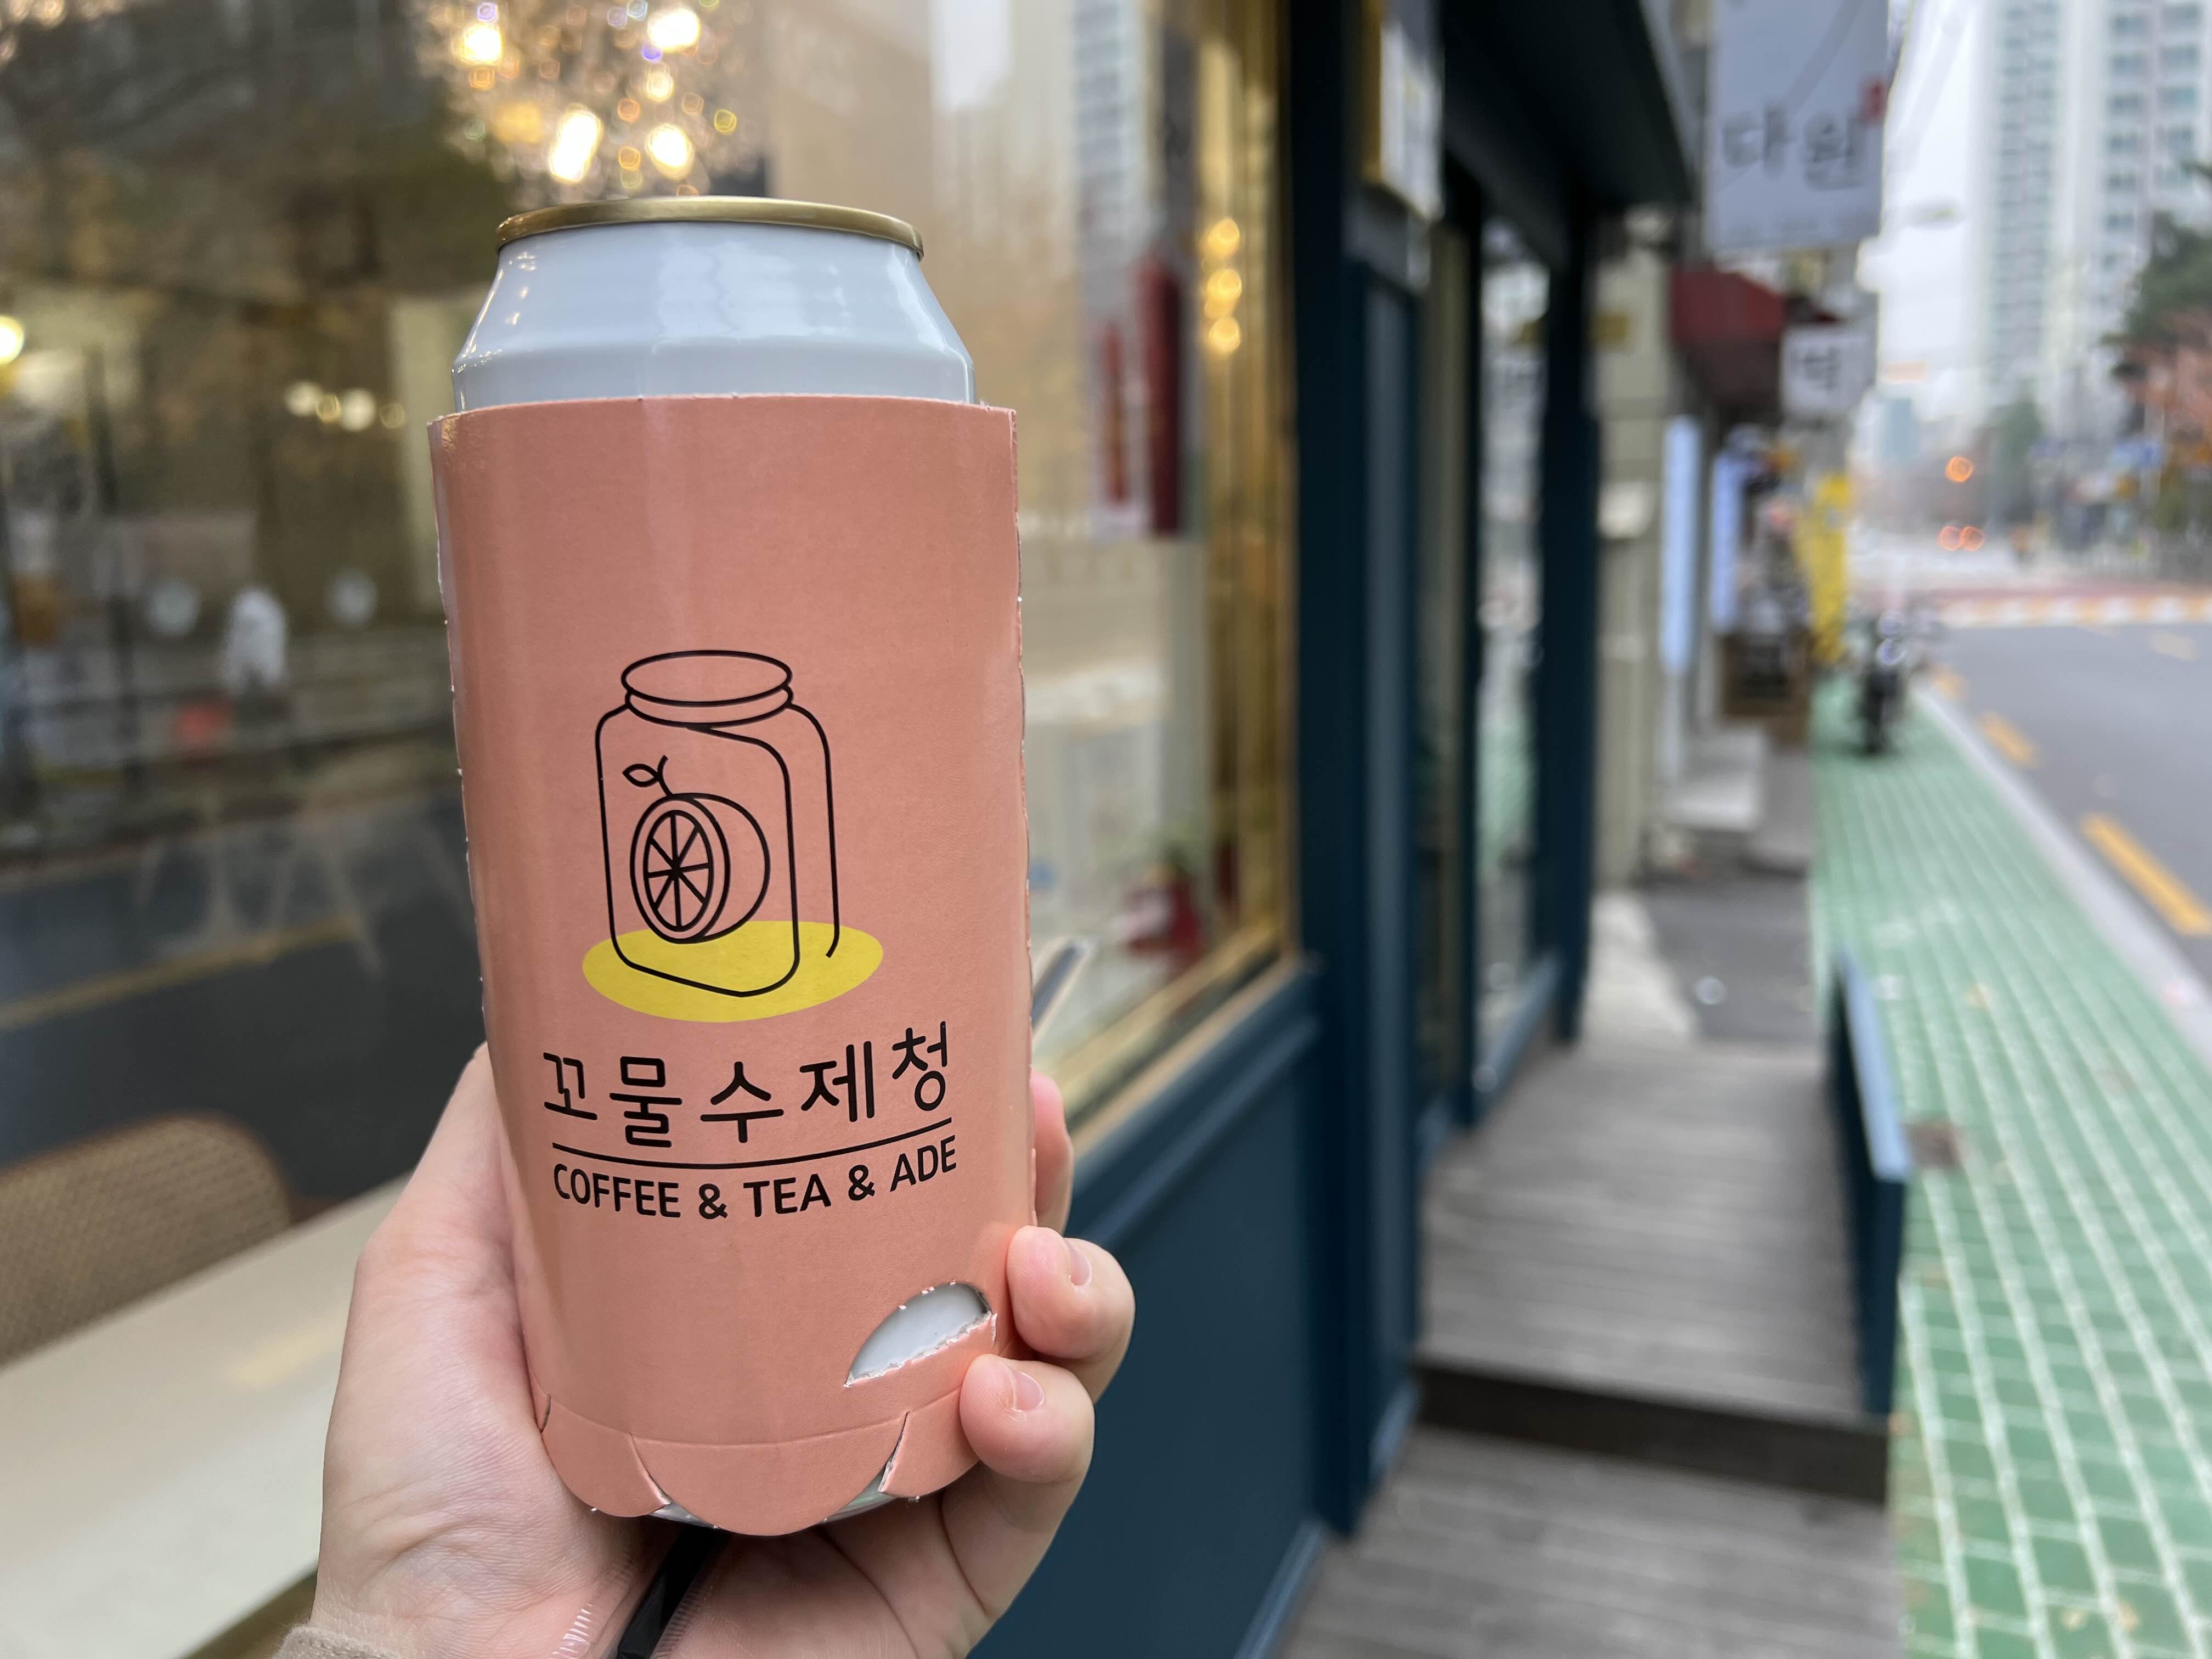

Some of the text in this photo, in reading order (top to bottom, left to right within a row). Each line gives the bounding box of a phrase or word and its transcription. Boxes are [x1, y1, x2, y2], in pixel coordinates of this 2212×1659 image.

[543, 1020, 948, 1148] 꼬물수제청
[554, 1135, 957, 1220] COFFEE & TEA & ADE
